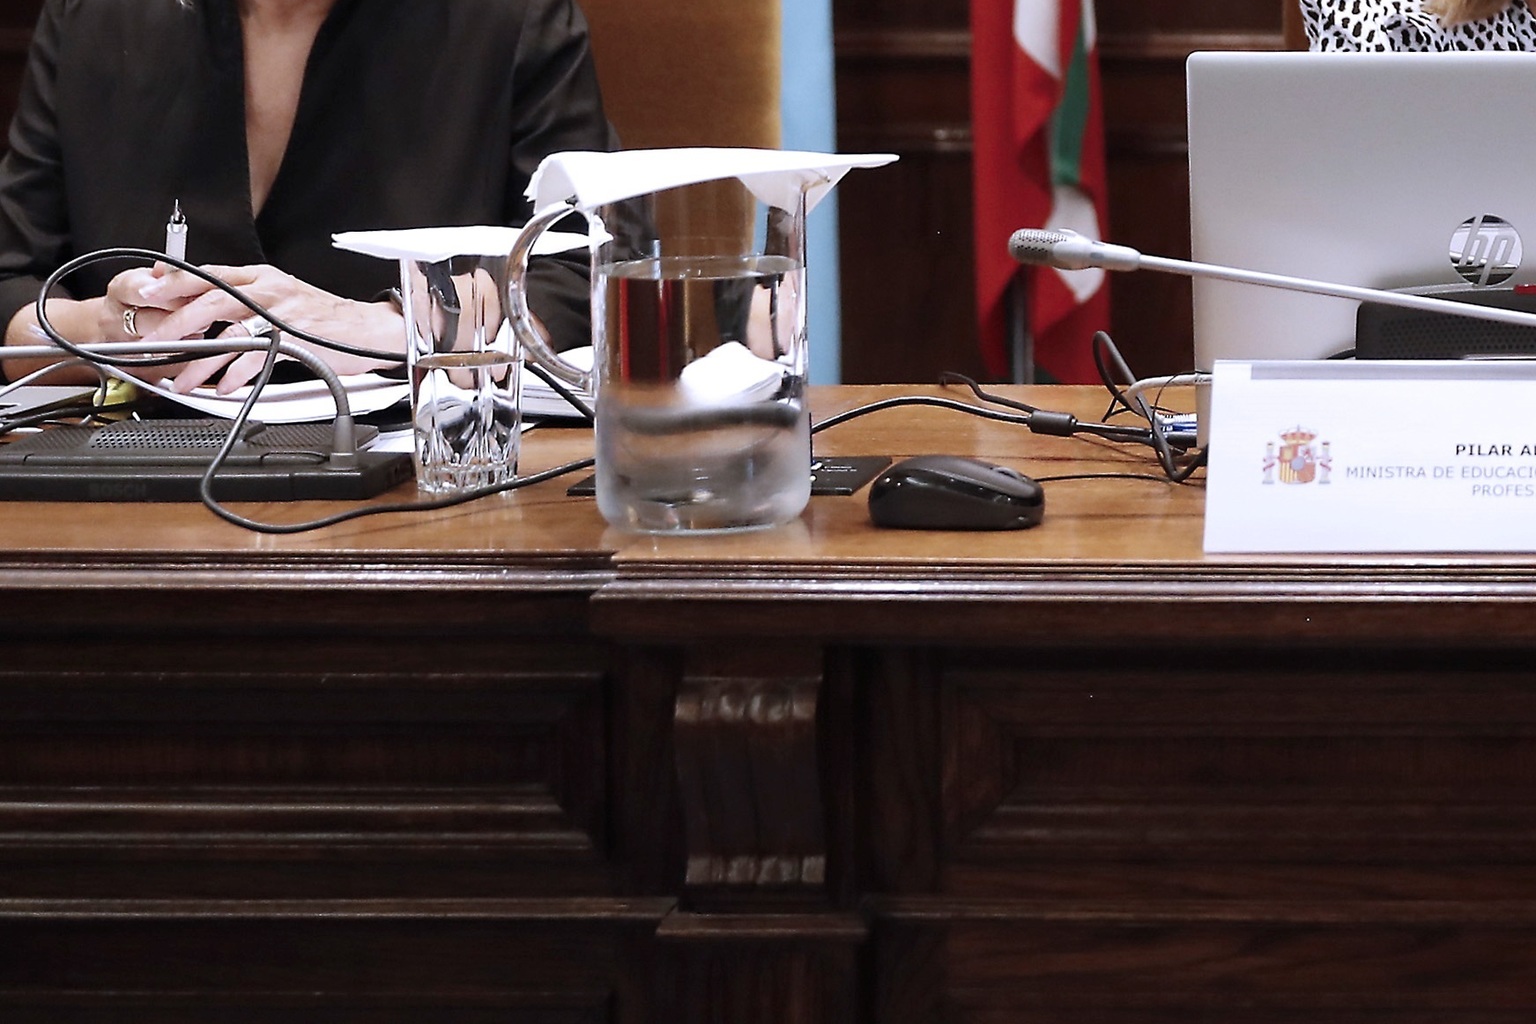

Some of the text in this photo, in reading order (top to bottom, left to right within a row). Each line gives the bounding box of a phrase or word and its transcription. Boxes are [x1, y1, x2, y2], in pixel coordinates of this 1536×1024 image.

[1453, 213, 1520, 287] hp
[1455, 443, 1513, 456] PILAR
[1345, 466, 1426, 478] MINISTRA
[1433, 466, 1453, 478] DE
